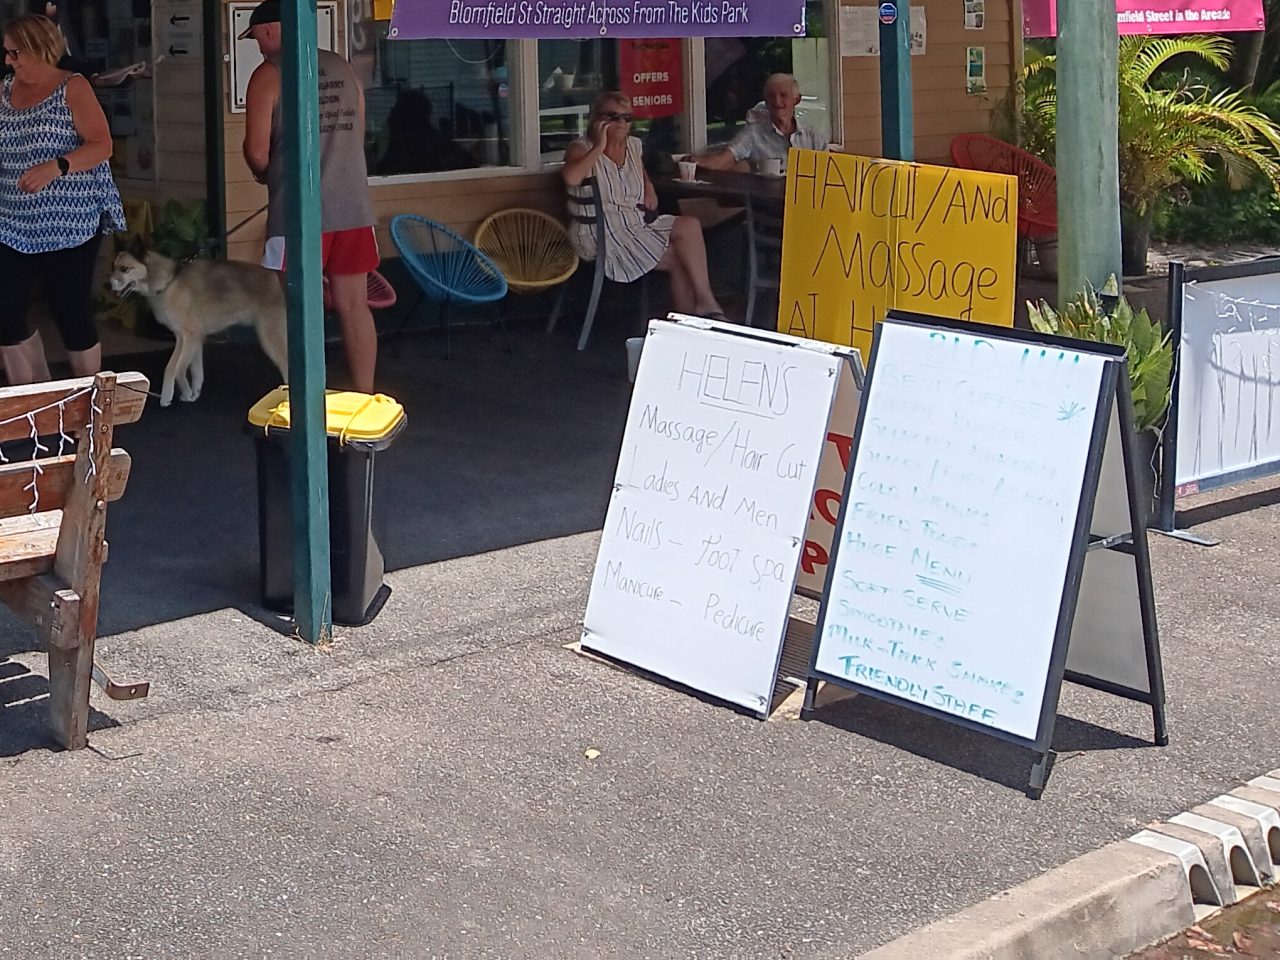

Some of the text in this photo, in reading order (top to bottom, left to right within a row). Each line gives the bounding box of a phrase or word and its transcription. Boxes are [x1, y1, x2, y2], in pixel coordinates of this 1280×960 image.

[518, 0, 532, 25] St
[533, 0, 587, 29] Straight
[586, 0, 631, 26] Across
[632, 0, 666, 25] From
[666, 0, 689, 24] The
[691, 0, 718, 24] Kids
[720, 1, 750, 24] Park
[1145, 10, 1174, 23] Street
[632, 71, 670, 85] OFFERS
[631, 95, 674, 108] SENIORS
[811, 223, 999, 322] Massage
[677, 351, 798, 417] HELEN'S
[776, 443, 808, 482] Cut
[628, 444, 680, 502] Ladies
[734, 497, 779, 531] Men
[615, 506, 664, 550] Nails
[911, 546, 972, 584] MENU
[704, 592, 766, 642] Pedicure
[903, 589, 971, 623] SERVE
